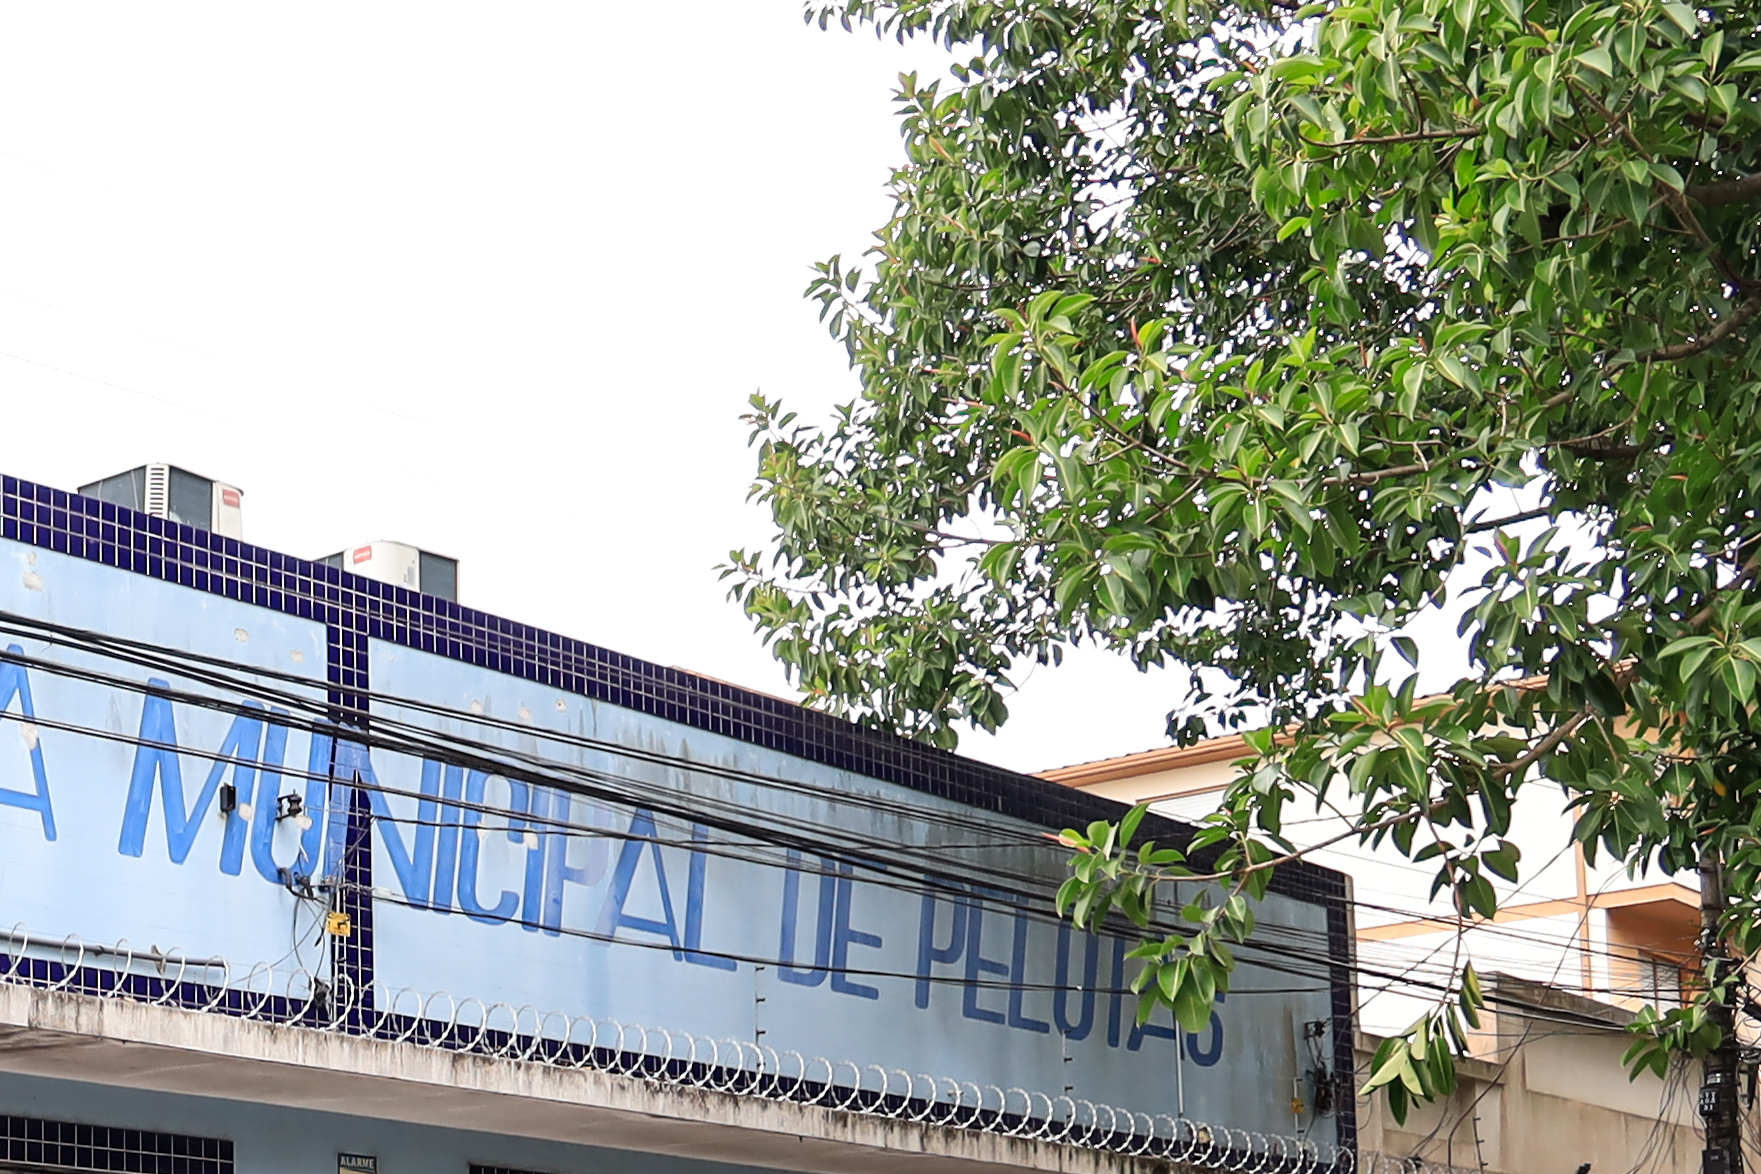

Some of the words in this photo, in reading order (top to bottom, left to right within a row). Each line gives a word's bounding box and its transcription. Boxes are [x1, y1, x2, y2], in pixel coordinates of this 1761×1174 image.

[118, 677, 738, 972] MUNICIPAL
[777, 845, 888, 1001] DE
[340, 1156, 375, 1169] ALARME
